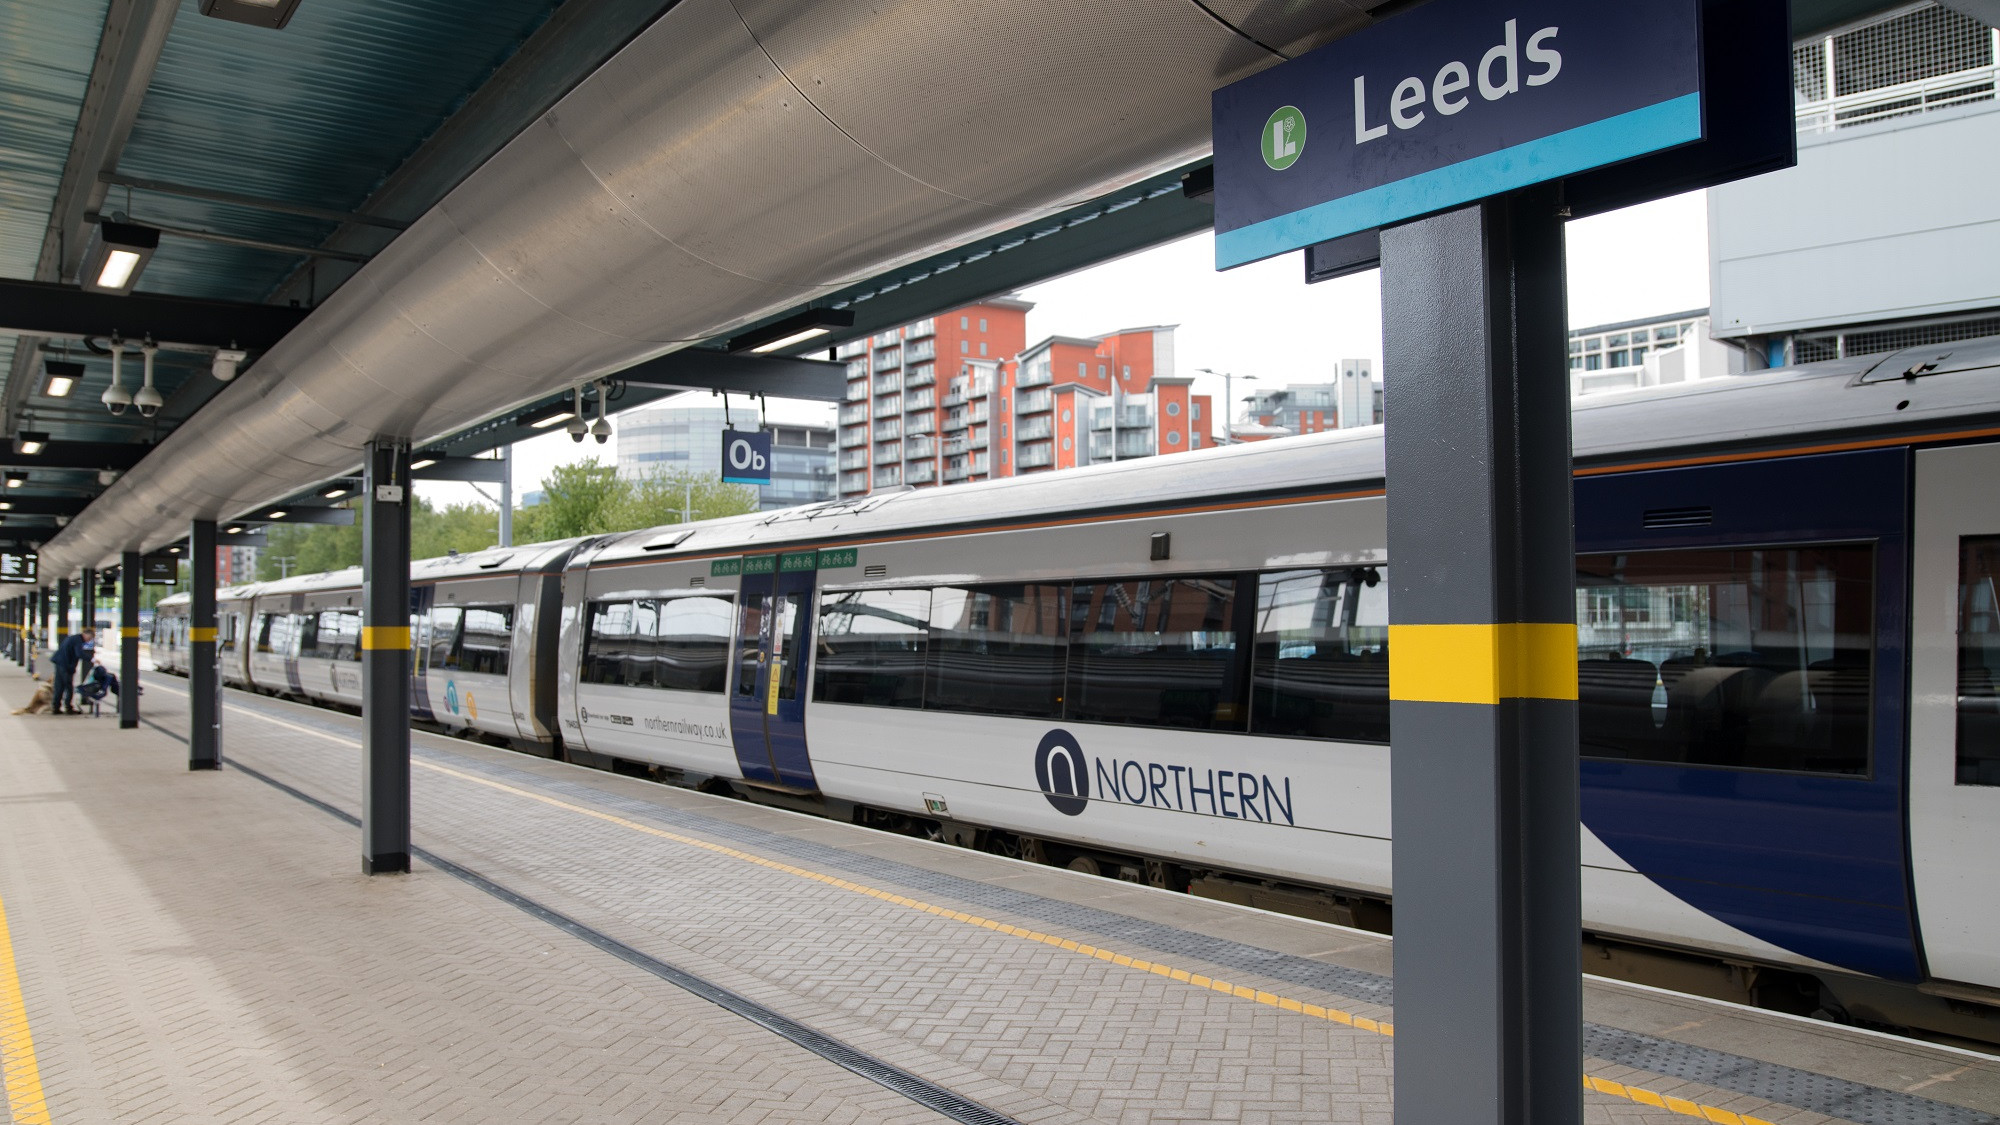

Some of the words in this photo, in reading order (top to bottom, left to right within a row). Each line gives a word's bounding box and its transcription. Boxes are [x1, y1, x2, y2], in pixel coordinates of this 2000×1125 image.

[1353, 17, 1563, 145] Leeds
[644, 715, 728, 740] northernrailway.co.uk
[1095, 756, 1294, 826] NORTHERN
